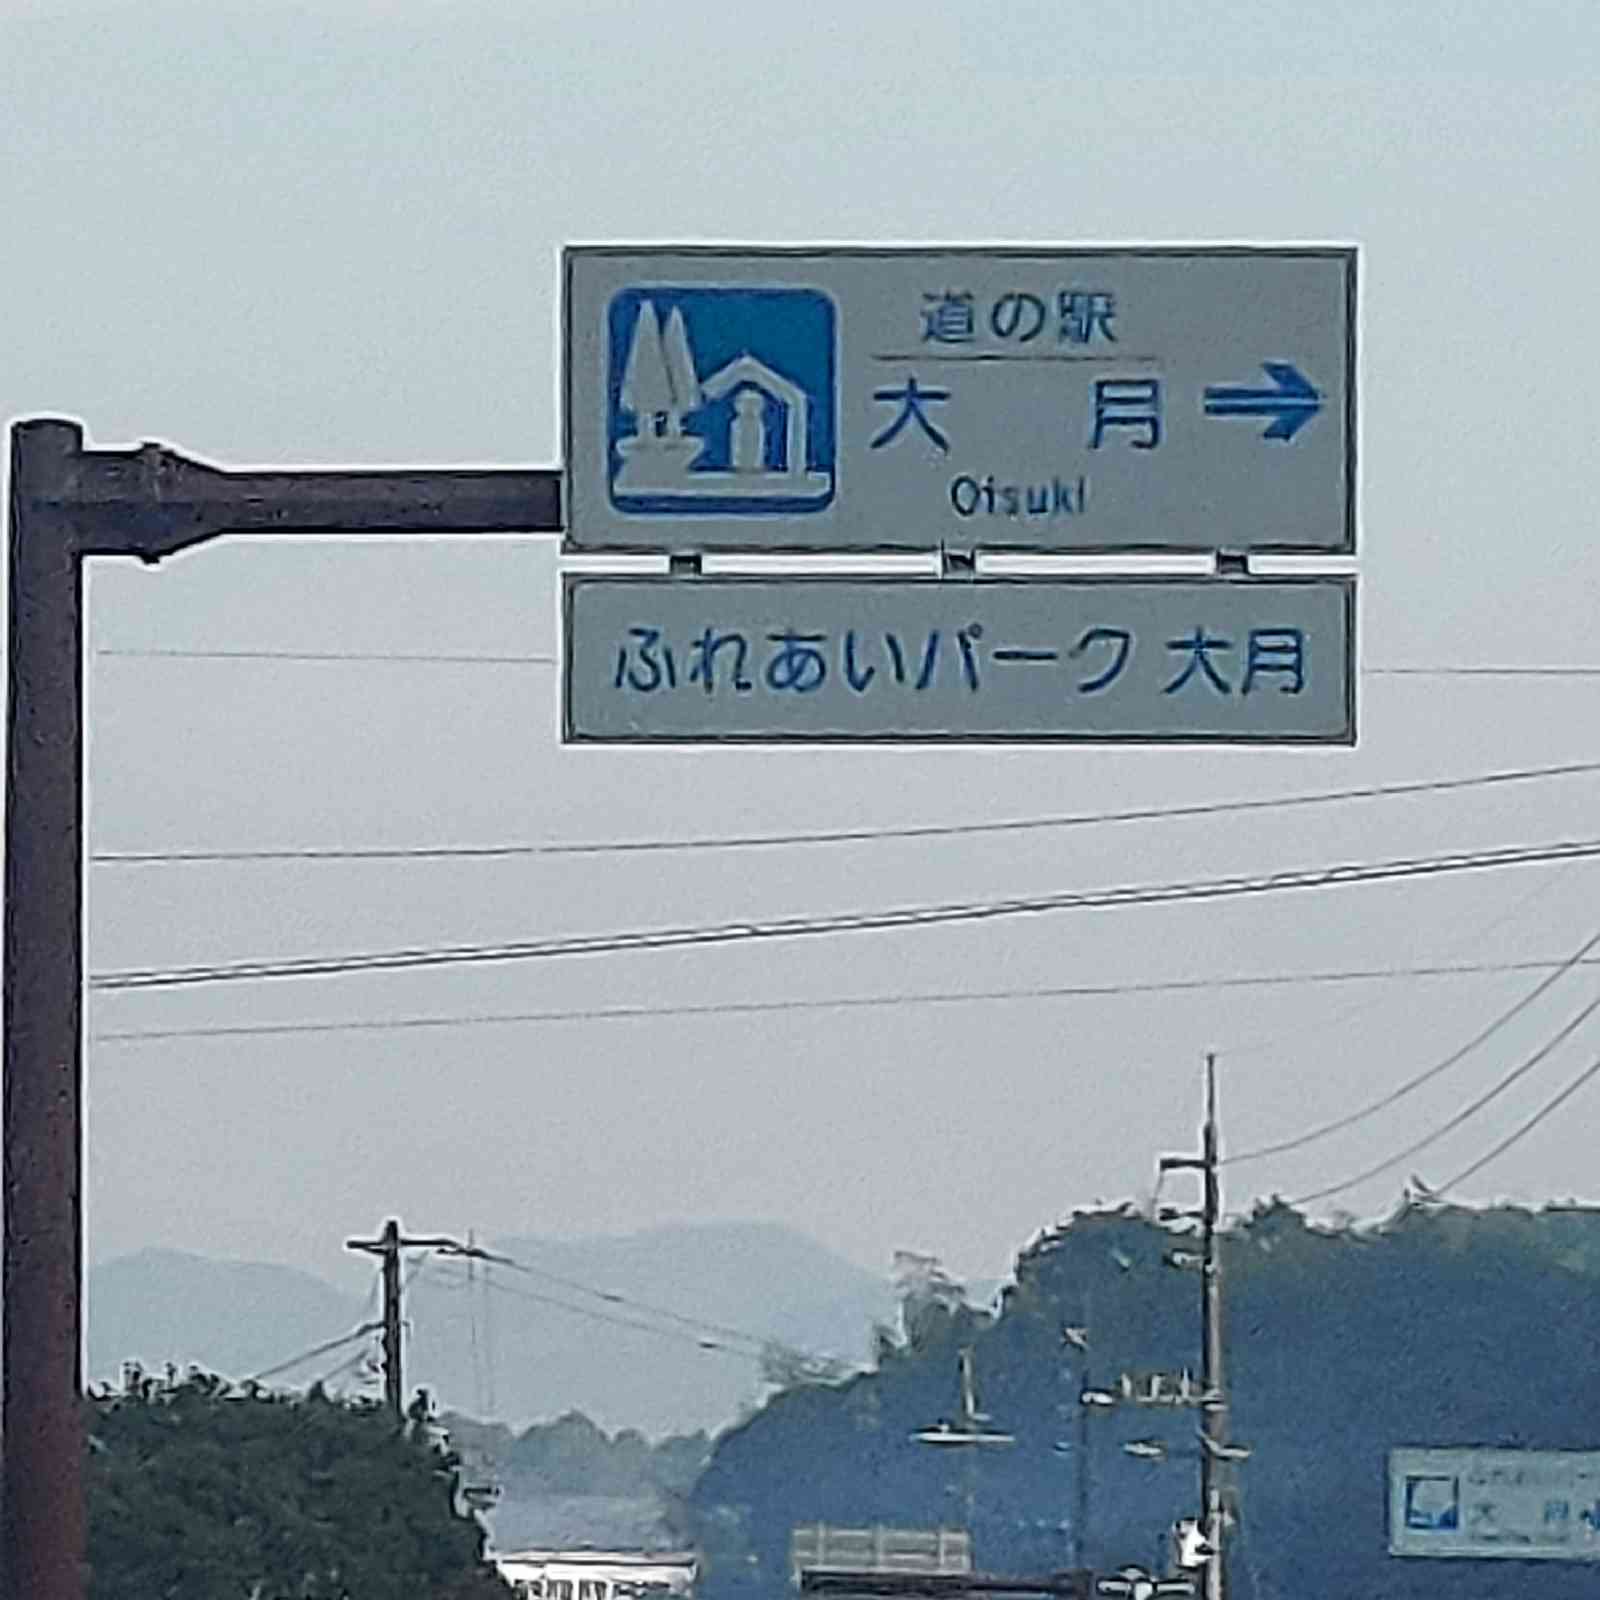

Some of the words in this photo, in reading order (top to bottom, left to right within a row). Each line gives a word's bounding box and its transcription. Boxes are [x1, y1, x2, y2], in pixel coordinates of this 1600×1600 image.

[921, 292, 1117, 343] 道の駅
[614, 623, 1131, 693] ふれあいパーク
[1161, 626, 1303, 694] 大月
